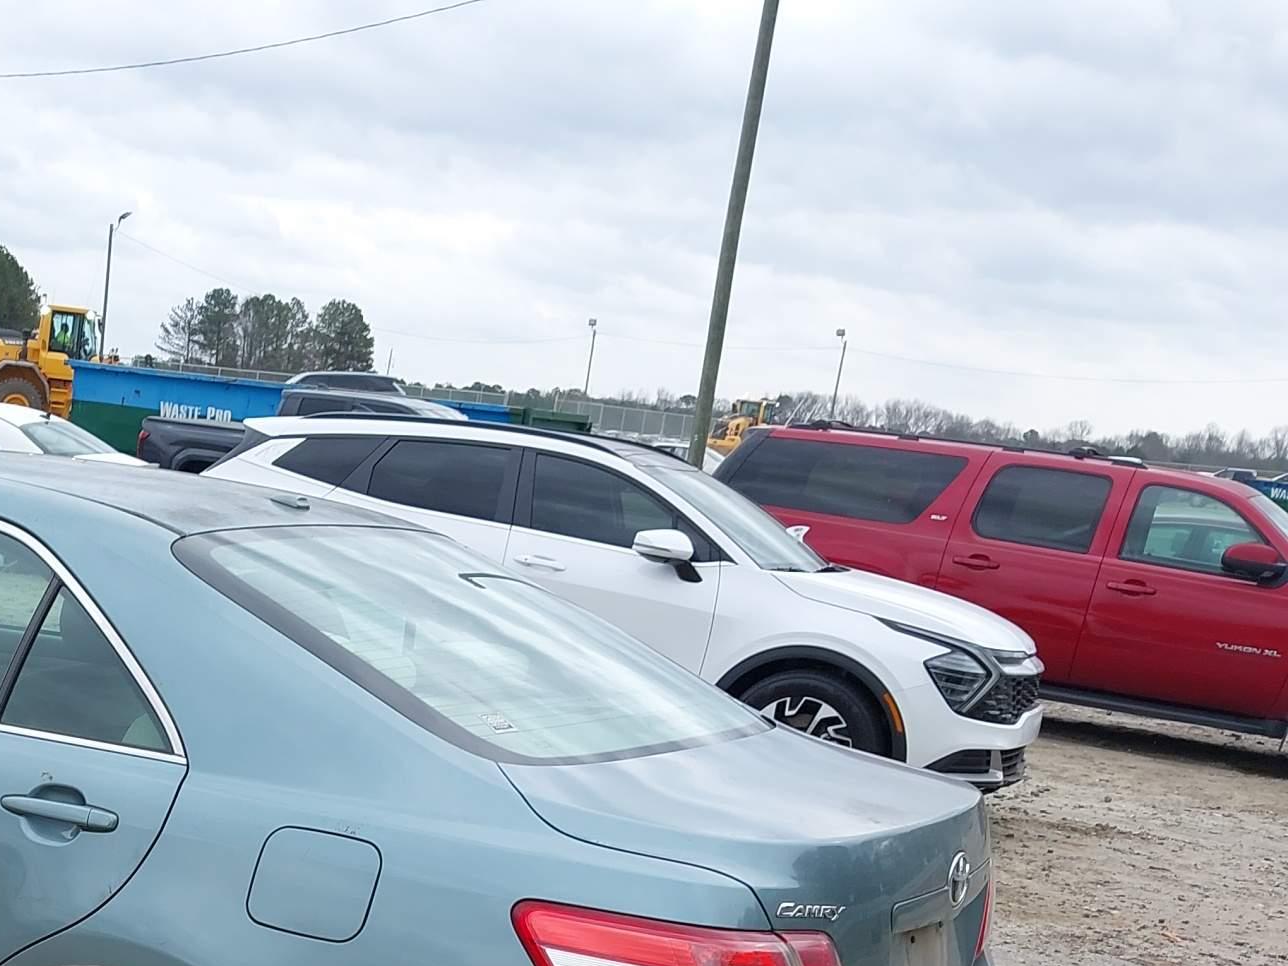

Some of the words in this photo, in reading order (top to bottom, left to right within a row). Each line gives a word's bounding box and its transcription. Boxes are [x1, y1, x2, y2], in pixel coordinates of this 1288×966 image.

[160, 401, 201, 420] WASTE
[207, 406, 232, 423] PRO
[1216, 642, 1262, 654] YUKON
[1262, 649, 1281, 657] XL
[776, 902, 846, 920] CAMRY
